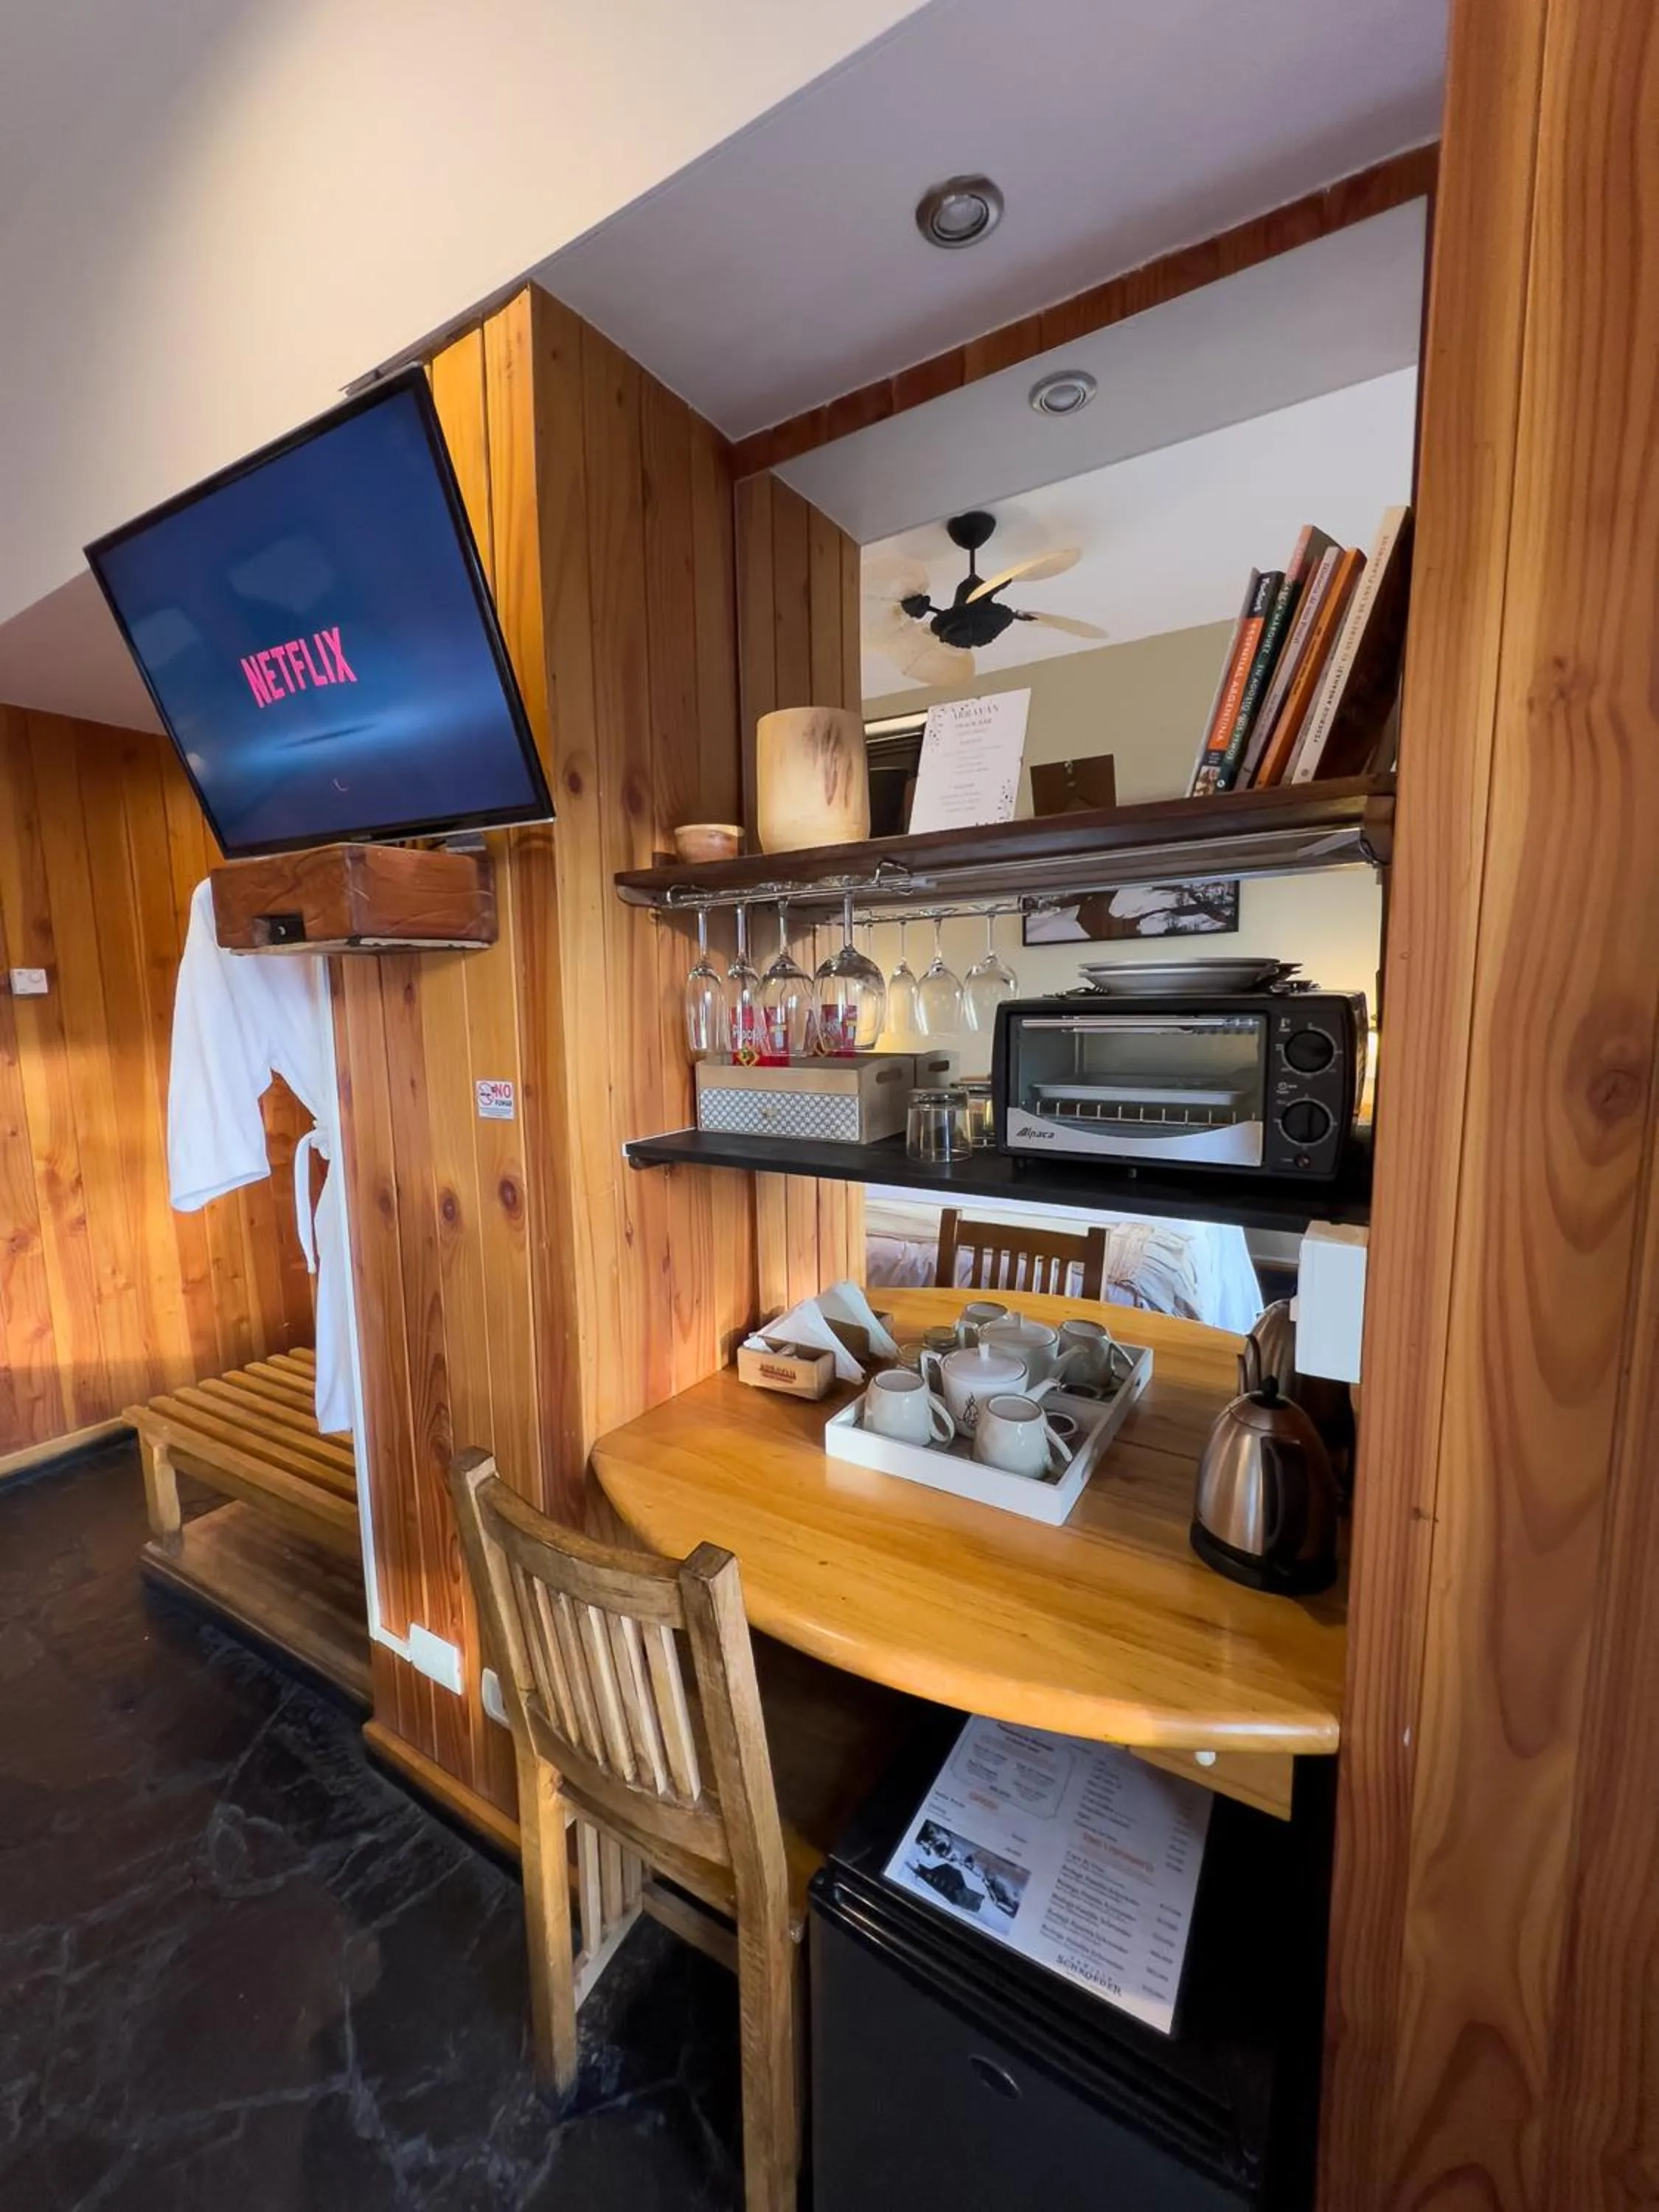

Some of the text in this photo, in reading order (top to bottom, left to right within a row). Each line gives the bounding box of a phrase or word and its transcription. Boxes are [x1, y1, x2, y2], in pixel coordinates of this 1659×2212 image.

[240, 627, 357, 708] NETFLIX
[1217, 680, 1239, 742] ARGENTINA
[495, 1084, 511, 1098] NO
